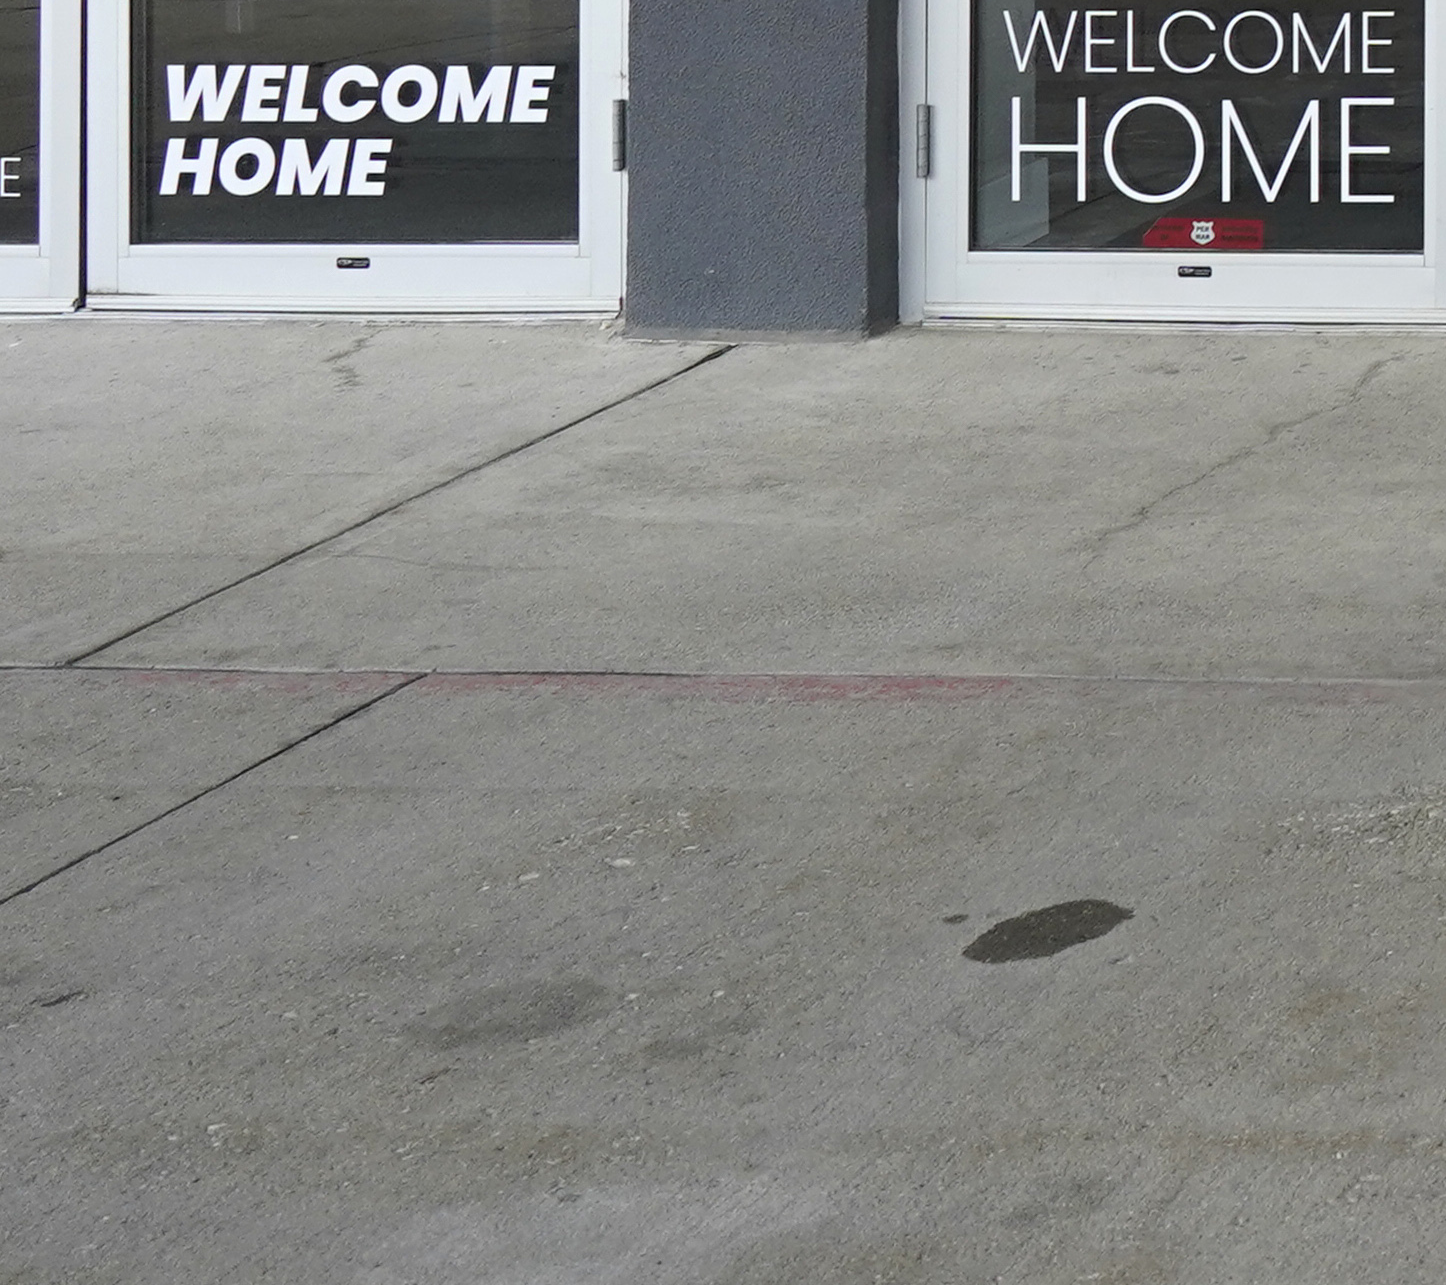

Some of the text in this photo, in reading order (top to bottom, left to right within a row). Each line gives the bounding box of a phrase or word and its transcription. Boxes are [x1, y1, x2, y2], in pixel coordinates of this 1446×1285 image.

[1003, 9, 1396, 74] WELCOME
[165, 64, 557, 123] WELCOME
[158, 137, 394, 196] HOME
[1011, 96, 1396, 204] HOME
